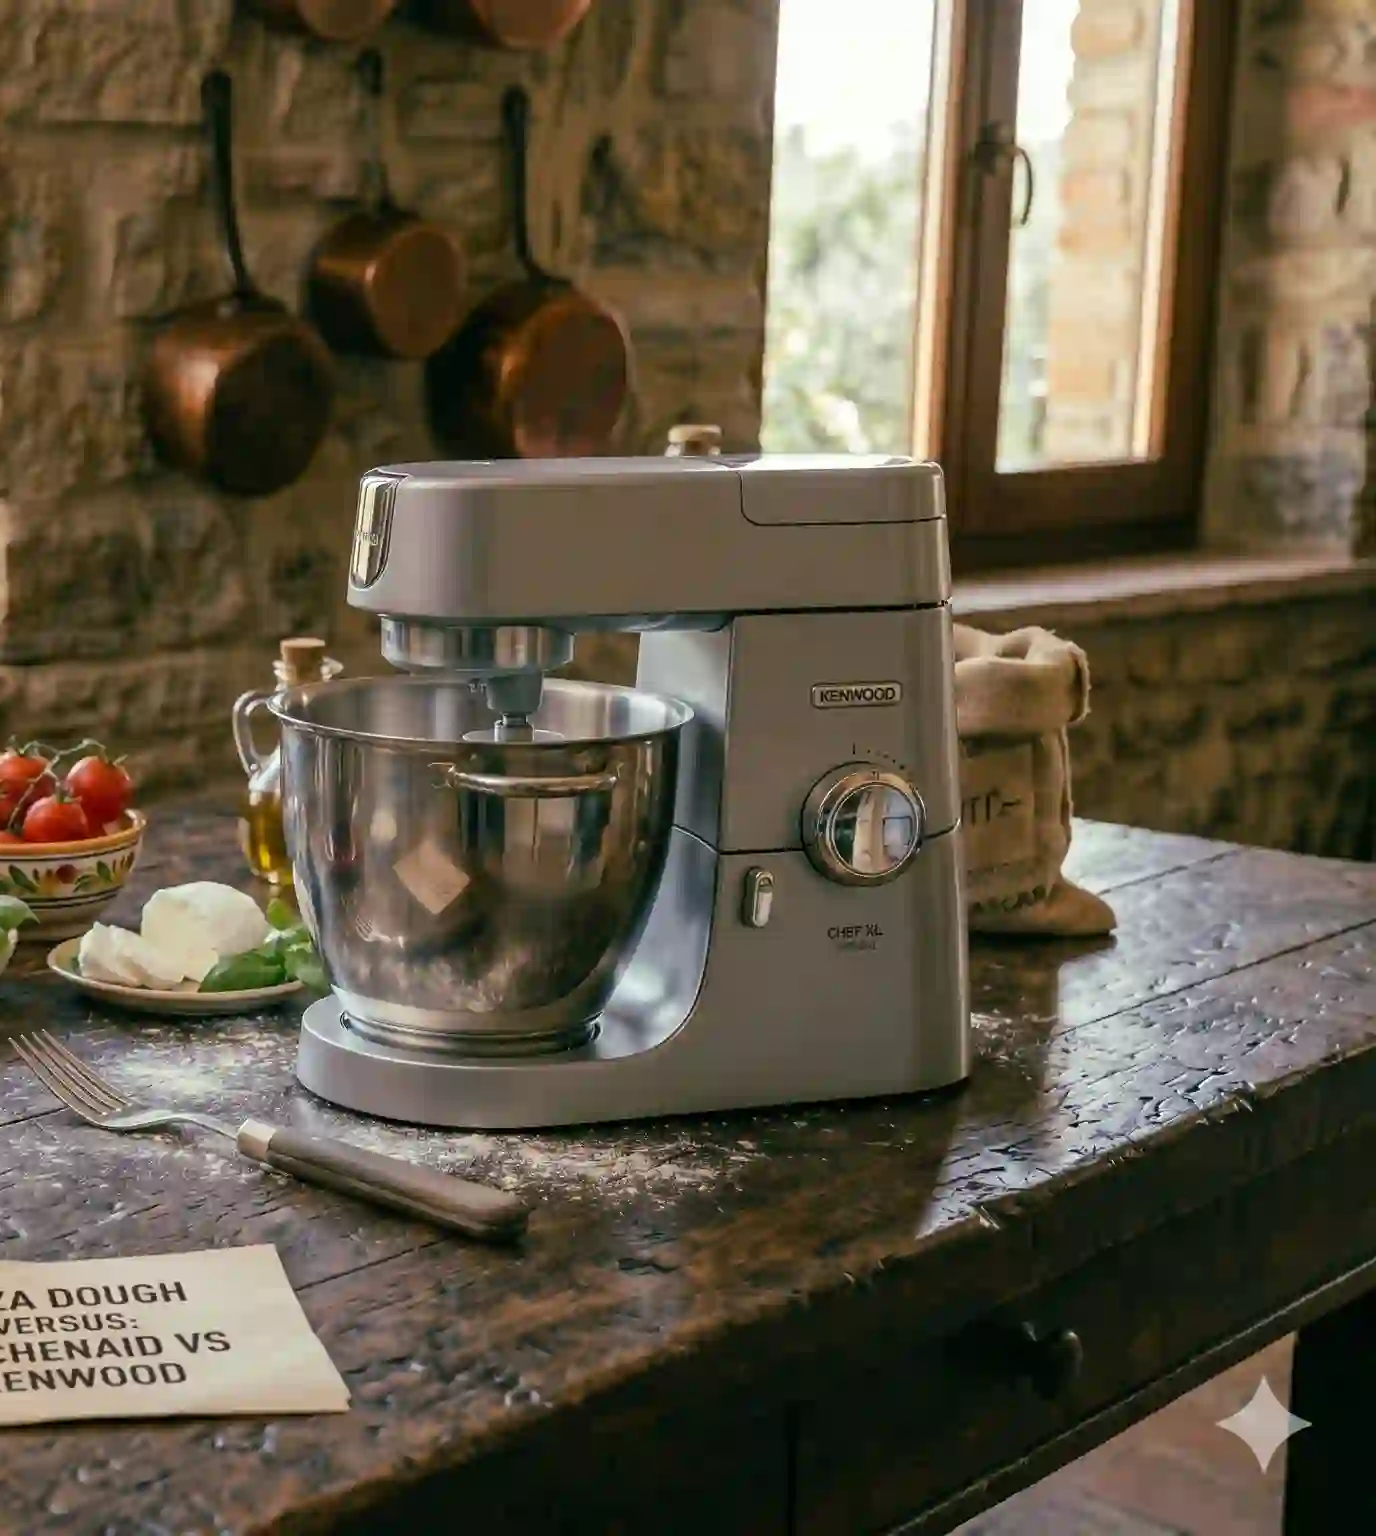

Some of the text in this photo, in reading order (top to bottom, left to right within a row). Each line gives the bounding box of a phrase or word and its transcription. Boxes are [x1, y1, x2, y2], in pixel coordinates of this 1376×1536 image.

[820, 687, 896, 702] KENWOOD
[827, 923, 885, 940] CHEF XL
[47, 1281, 188, 1309] DOUGH
[174, 1331, 231, 1354] VS
